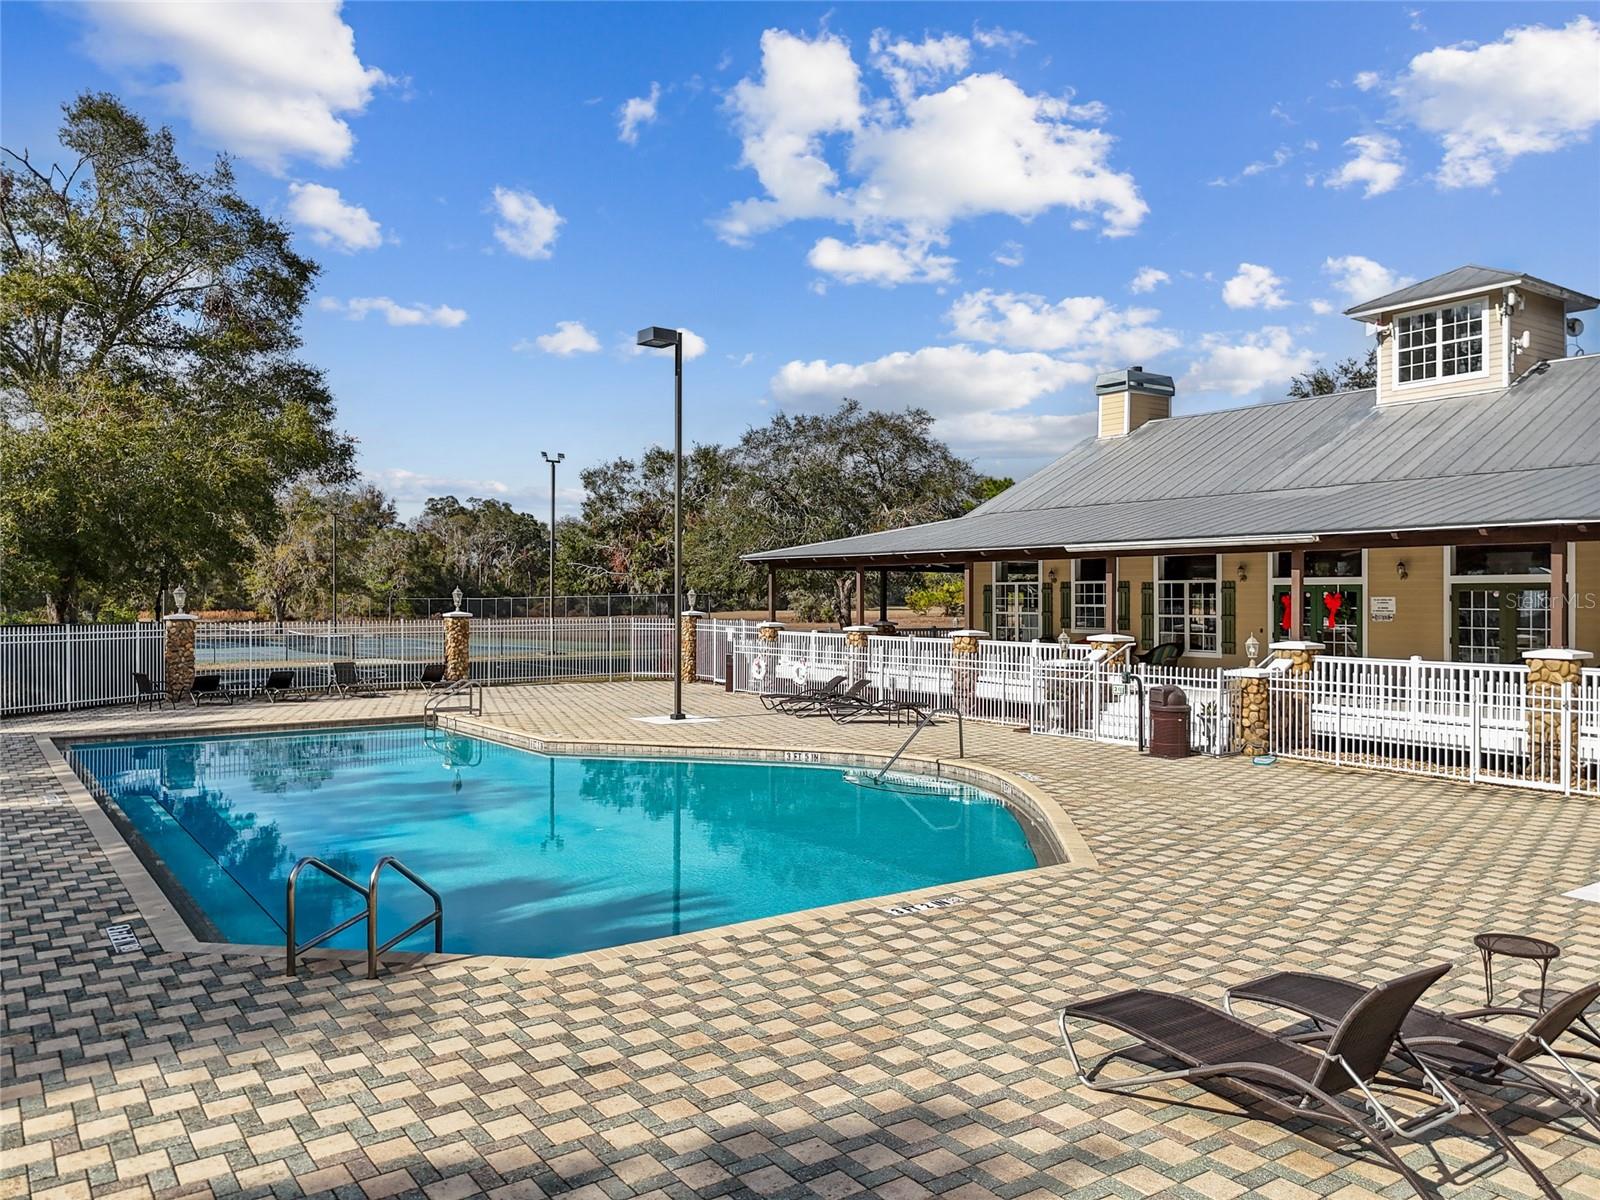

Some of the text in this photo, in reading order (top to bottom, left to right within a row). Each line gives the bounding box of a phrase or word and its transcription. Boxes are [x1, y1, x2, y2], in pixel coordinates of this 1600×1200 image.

[793, 752, 802, 761] FT
[811, 753, 819, 762] IN
[930, 899, 951, 908] IN
